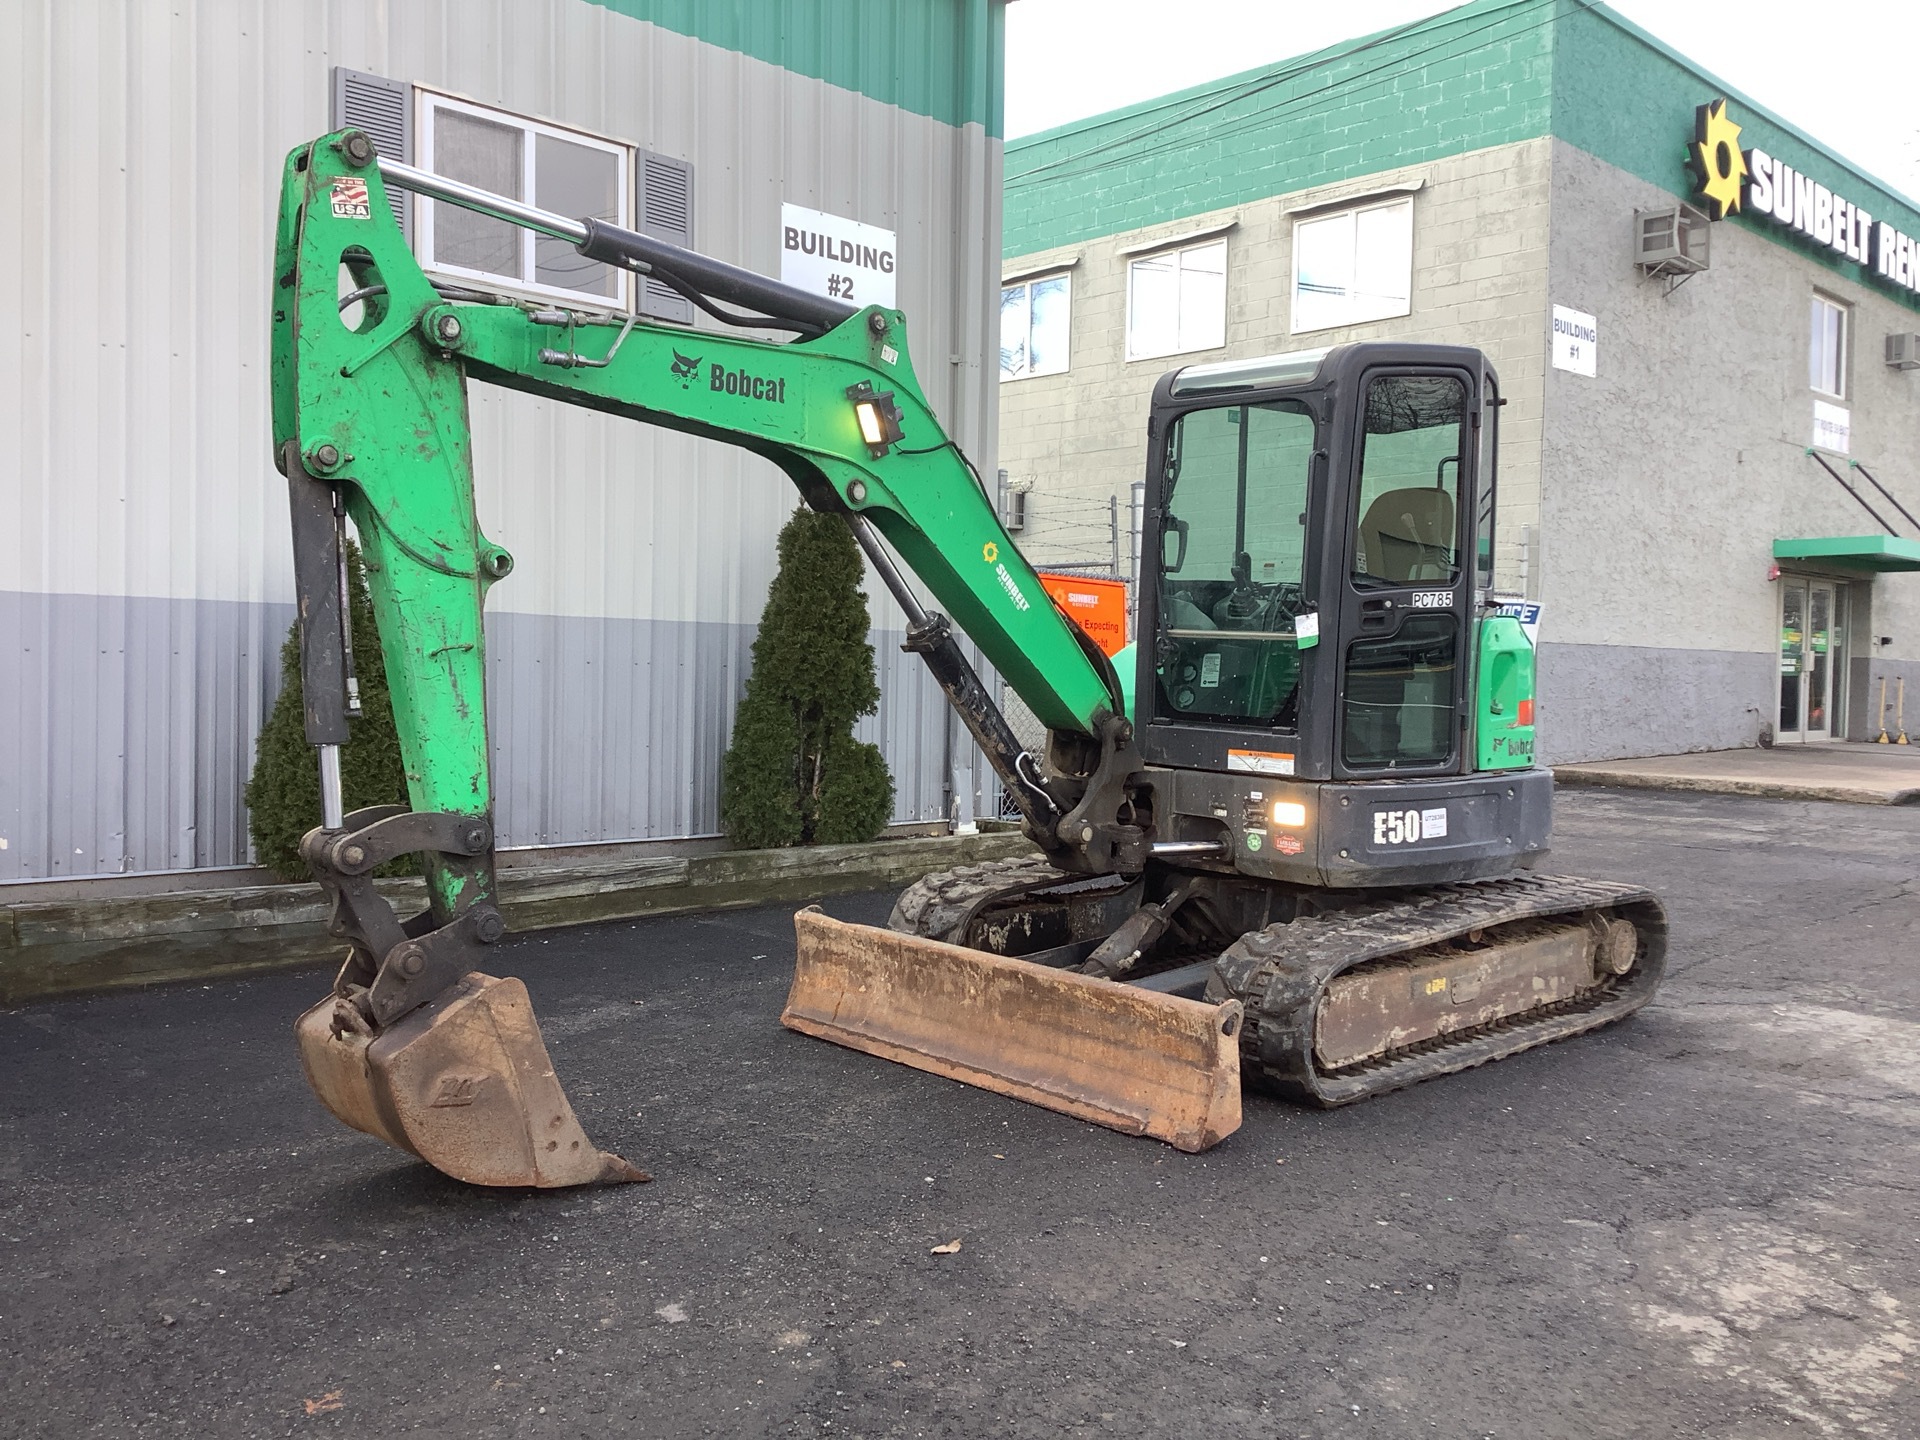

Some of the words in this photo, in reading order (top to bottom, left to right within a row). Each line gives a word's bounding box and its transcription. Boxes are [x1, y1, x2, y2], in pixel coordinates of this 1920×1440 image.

[334, 204, 367, 215] USA
[1751, 147, 1872, 265] SUNBELT
[784, 225, 894, 274] BUILDING
[827, 273, 854, 300] #2
[1554, 317, 1596, 343] BUILDING
[1569, 344, 1580, 360] #1
[710, 363, 785, 404] Bobcat
[996, 563, 1030, 611] SUNBELT
[1068, 592, 1099, 604] SUNBELT
[1413, 593, 1452, 607] PC785
[1496, 604, 1538, 622] TICE
[1084, 619, 1119, 634] Expecting
[1373, 809, 1420, 845] E50
